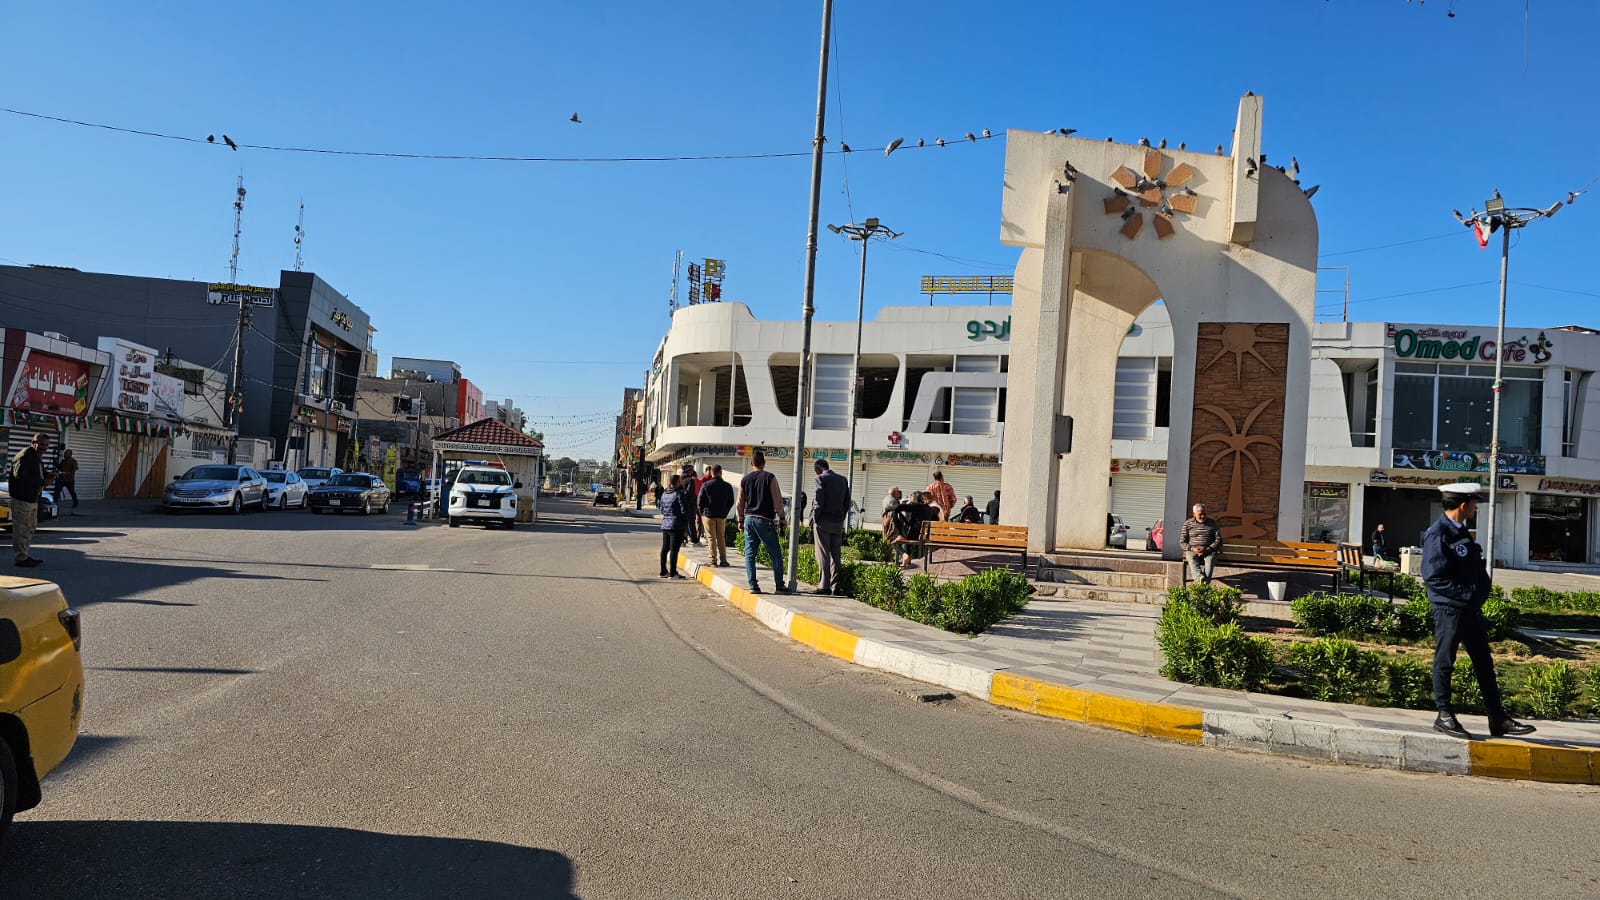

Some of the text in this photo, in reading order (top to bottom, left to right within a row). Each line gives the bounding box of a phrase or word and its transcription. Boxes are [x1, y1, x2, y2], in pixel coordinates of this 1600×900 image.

[705, 258, 726, 279] B2
[1395, 329, 1480, 360] Omed
[1432, 454, 1473, 470] Omed
